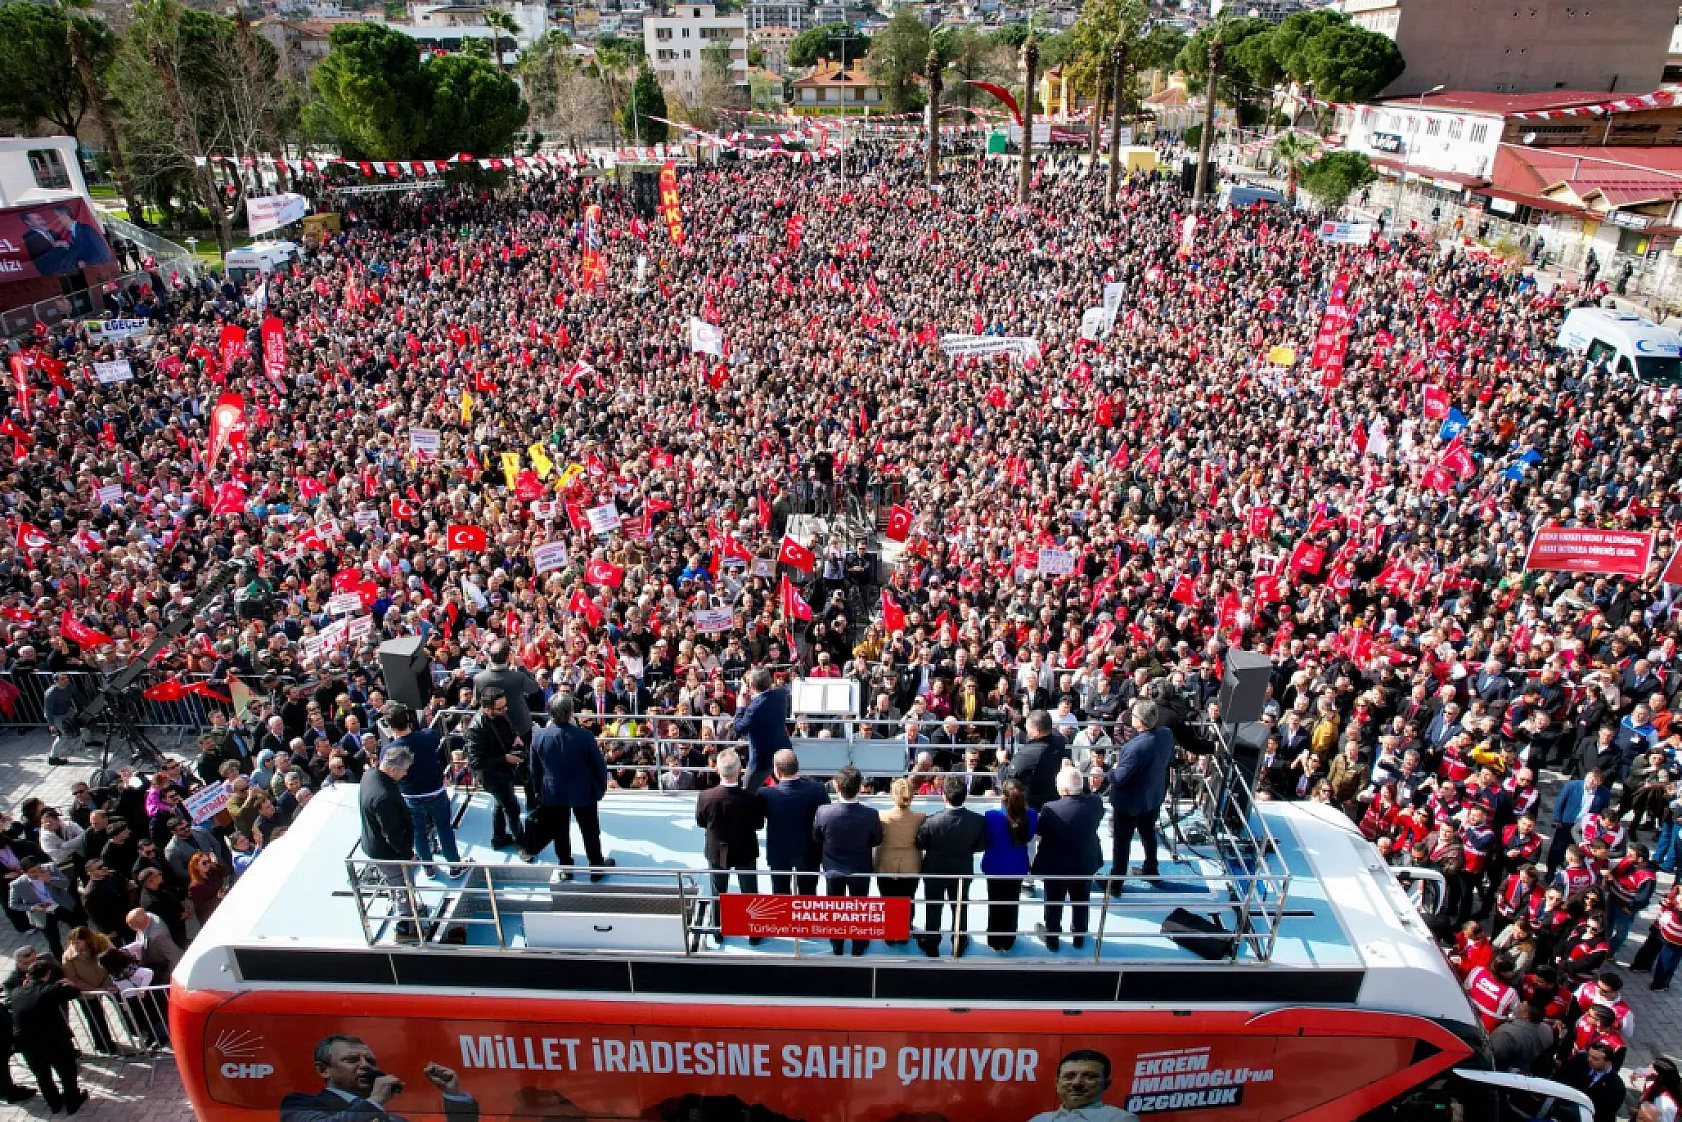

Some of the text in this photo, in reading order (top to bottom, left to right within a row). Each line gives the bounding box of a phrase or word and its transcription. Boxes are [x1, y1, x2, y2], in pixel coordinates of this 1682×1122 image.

[791, 899, 886, 912] CUMHURİYET
[791, 911, 886, 923] HALK PARTİSİ
[749, 923, 885, 936] Türkiye'nin Birinci Partisi
[220, 1062, 274, 1079] CHP
[897, 1047, 1039, 1087] ÇIKIYOR
[1134, 1054, 1210, 1077] EKREM
[1128, 1087, 1237, 1113] ÖZGÜRLÜK
